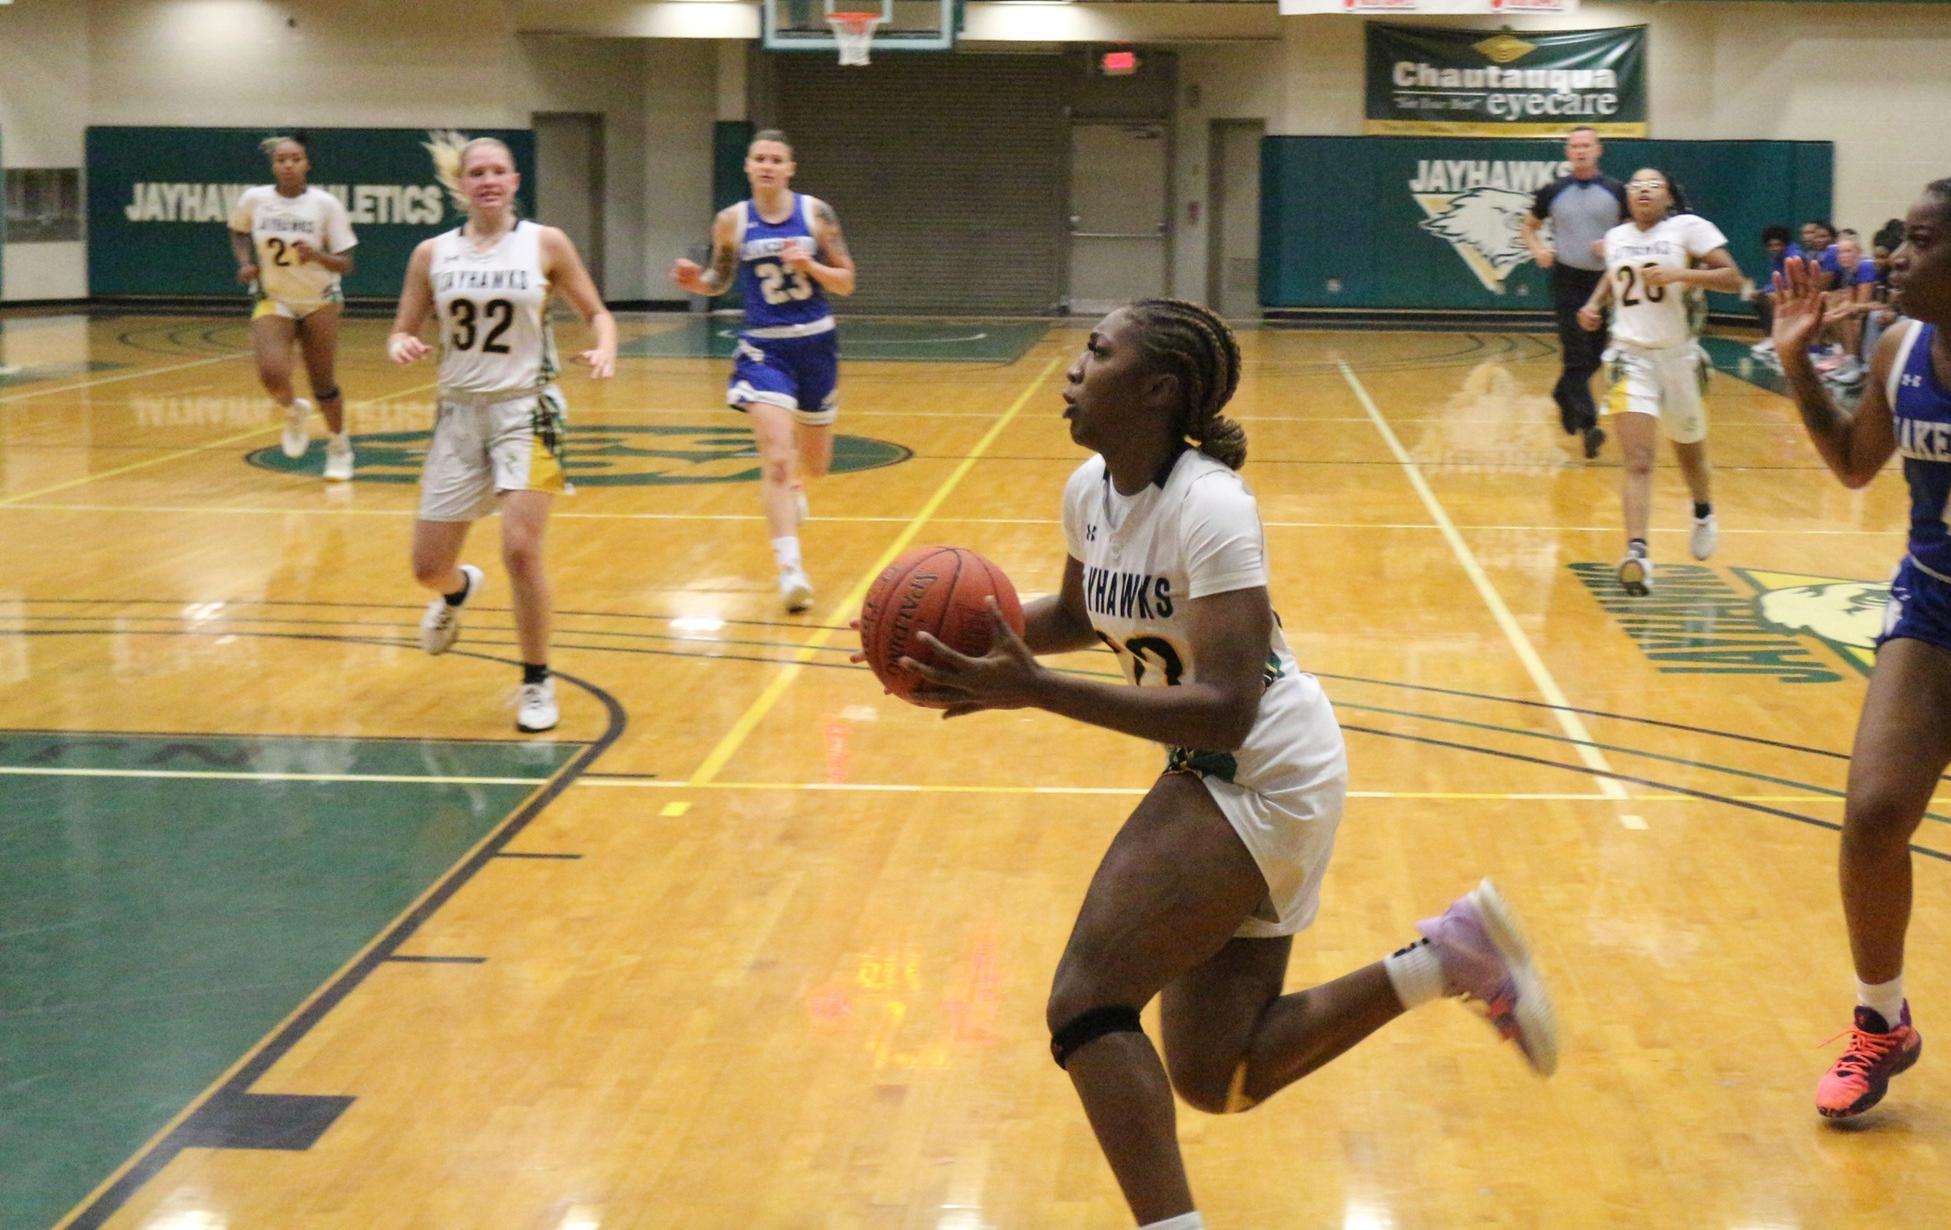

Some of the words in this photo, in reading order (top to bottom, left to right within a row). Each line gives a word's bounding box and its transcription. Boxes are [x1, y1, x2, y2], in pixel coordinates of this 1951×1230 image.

[1392, 61, 1617, 94] Chautauqua
[1486, 93, 1619, 121] eyecare
[754, 262, 814, 305] 23
[451, 298, 514, 354] 32
[1087, 566, 1174, 619] YHAWKS
